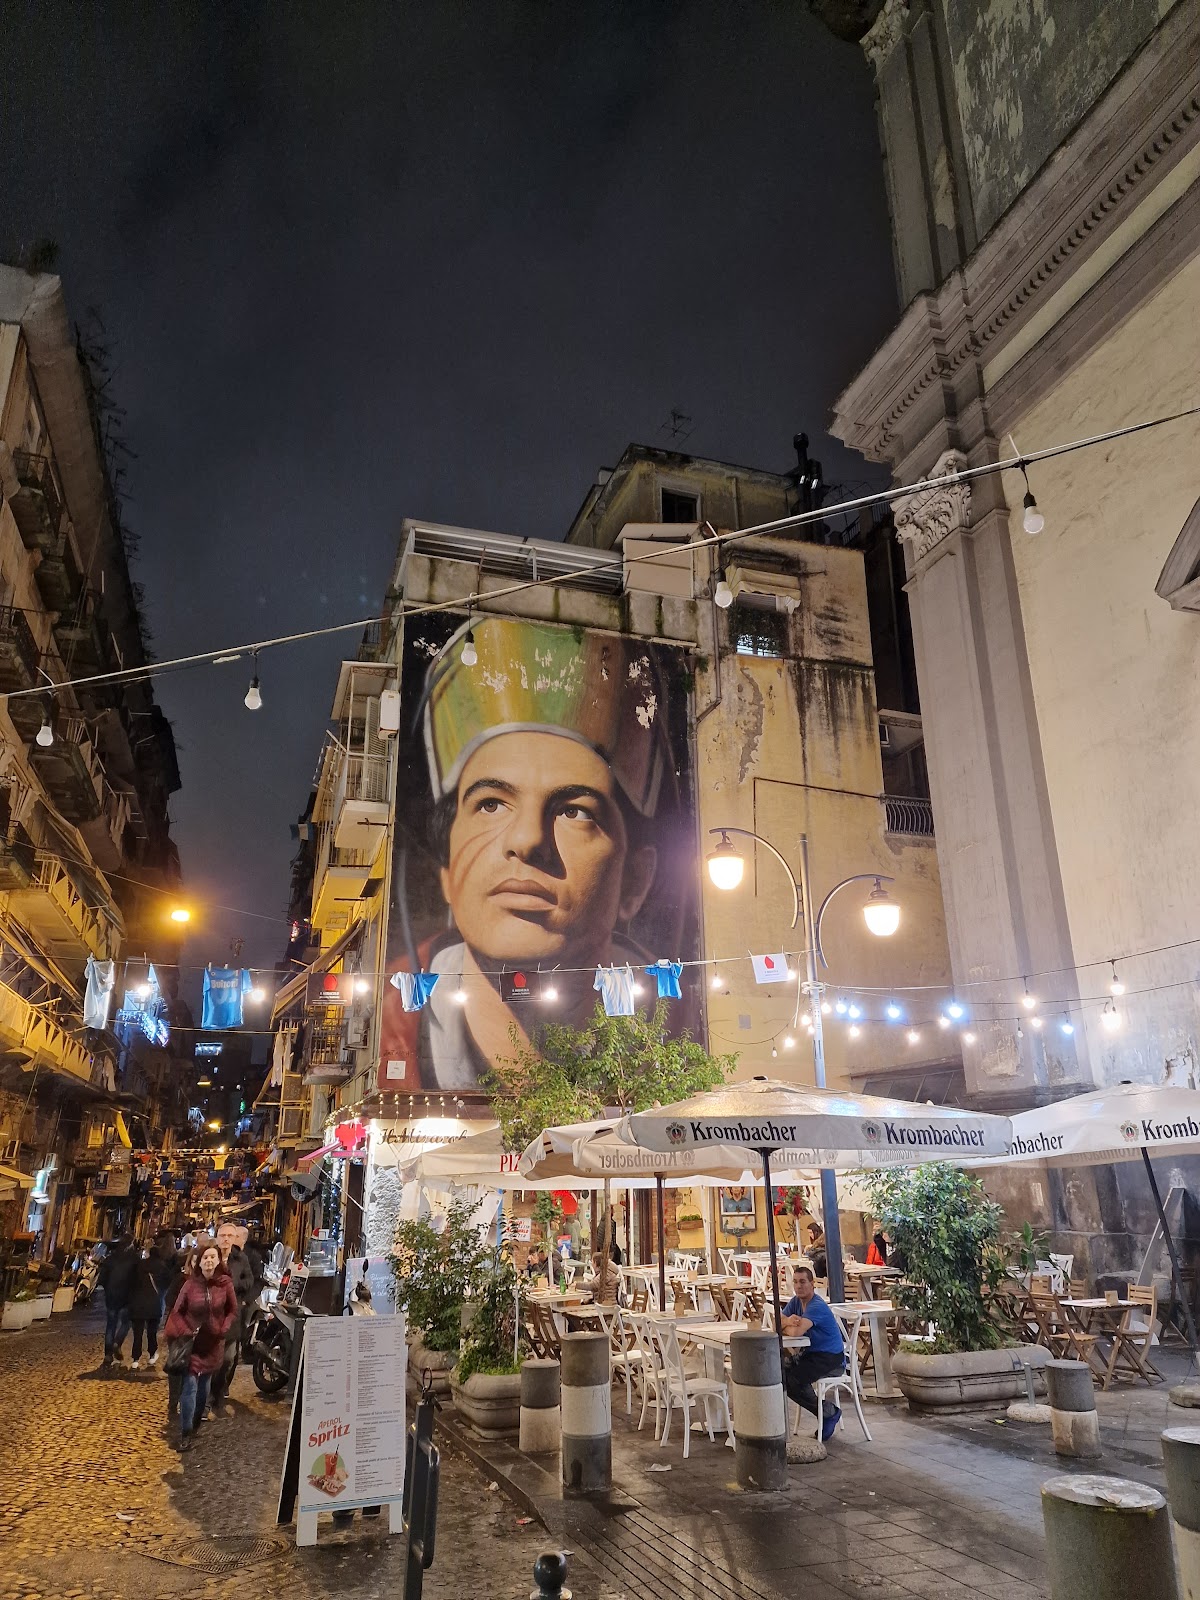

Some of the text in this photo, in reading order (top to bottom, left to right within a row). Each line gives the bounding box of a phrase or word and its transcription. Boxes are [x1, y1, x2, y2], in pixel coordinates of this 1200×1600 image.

[689, 1120, 797, 1141] Krombacher
[883, 1121, 985, 1146] Krombacher
[1141, 1115, 1200, 1141] Kromb
[499, 1152, 523, 1173] PIZ
[308, 1423, 351, 1448] Spritz
